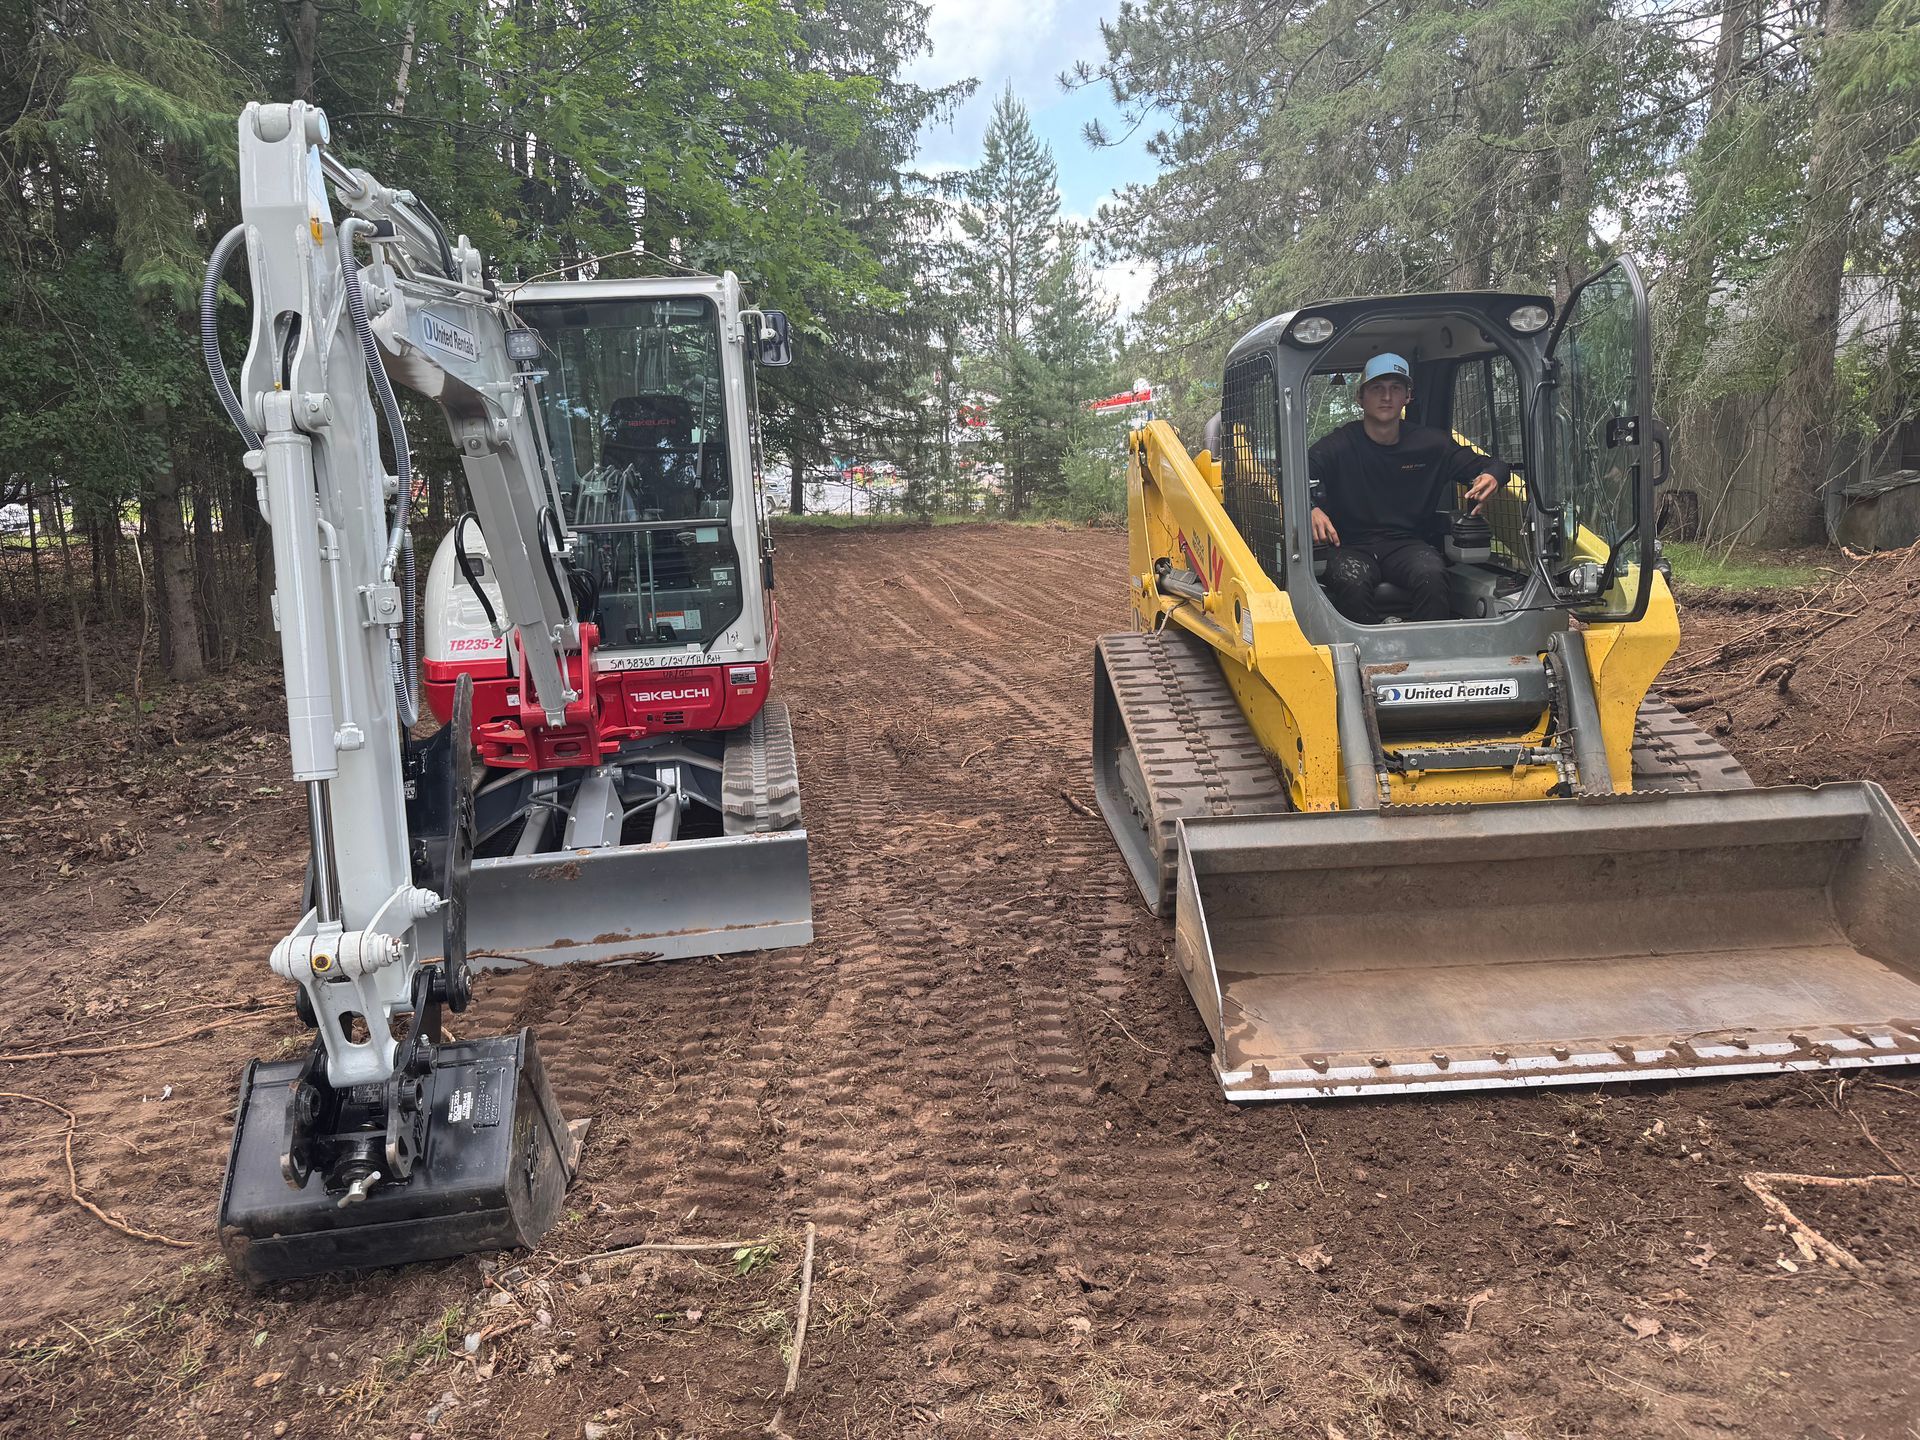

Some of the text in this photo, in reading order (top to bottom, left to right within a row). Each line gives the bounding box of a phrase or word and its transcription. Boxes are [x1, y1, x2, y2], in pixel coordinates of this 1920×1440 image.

[432, 320, 474, 356] United Rentals
[450, 637, 504, 651] TB235-2
[630, 687, 710, 702] TAKEUCHI
[1404, 683, 1511, 700] United Rentals
